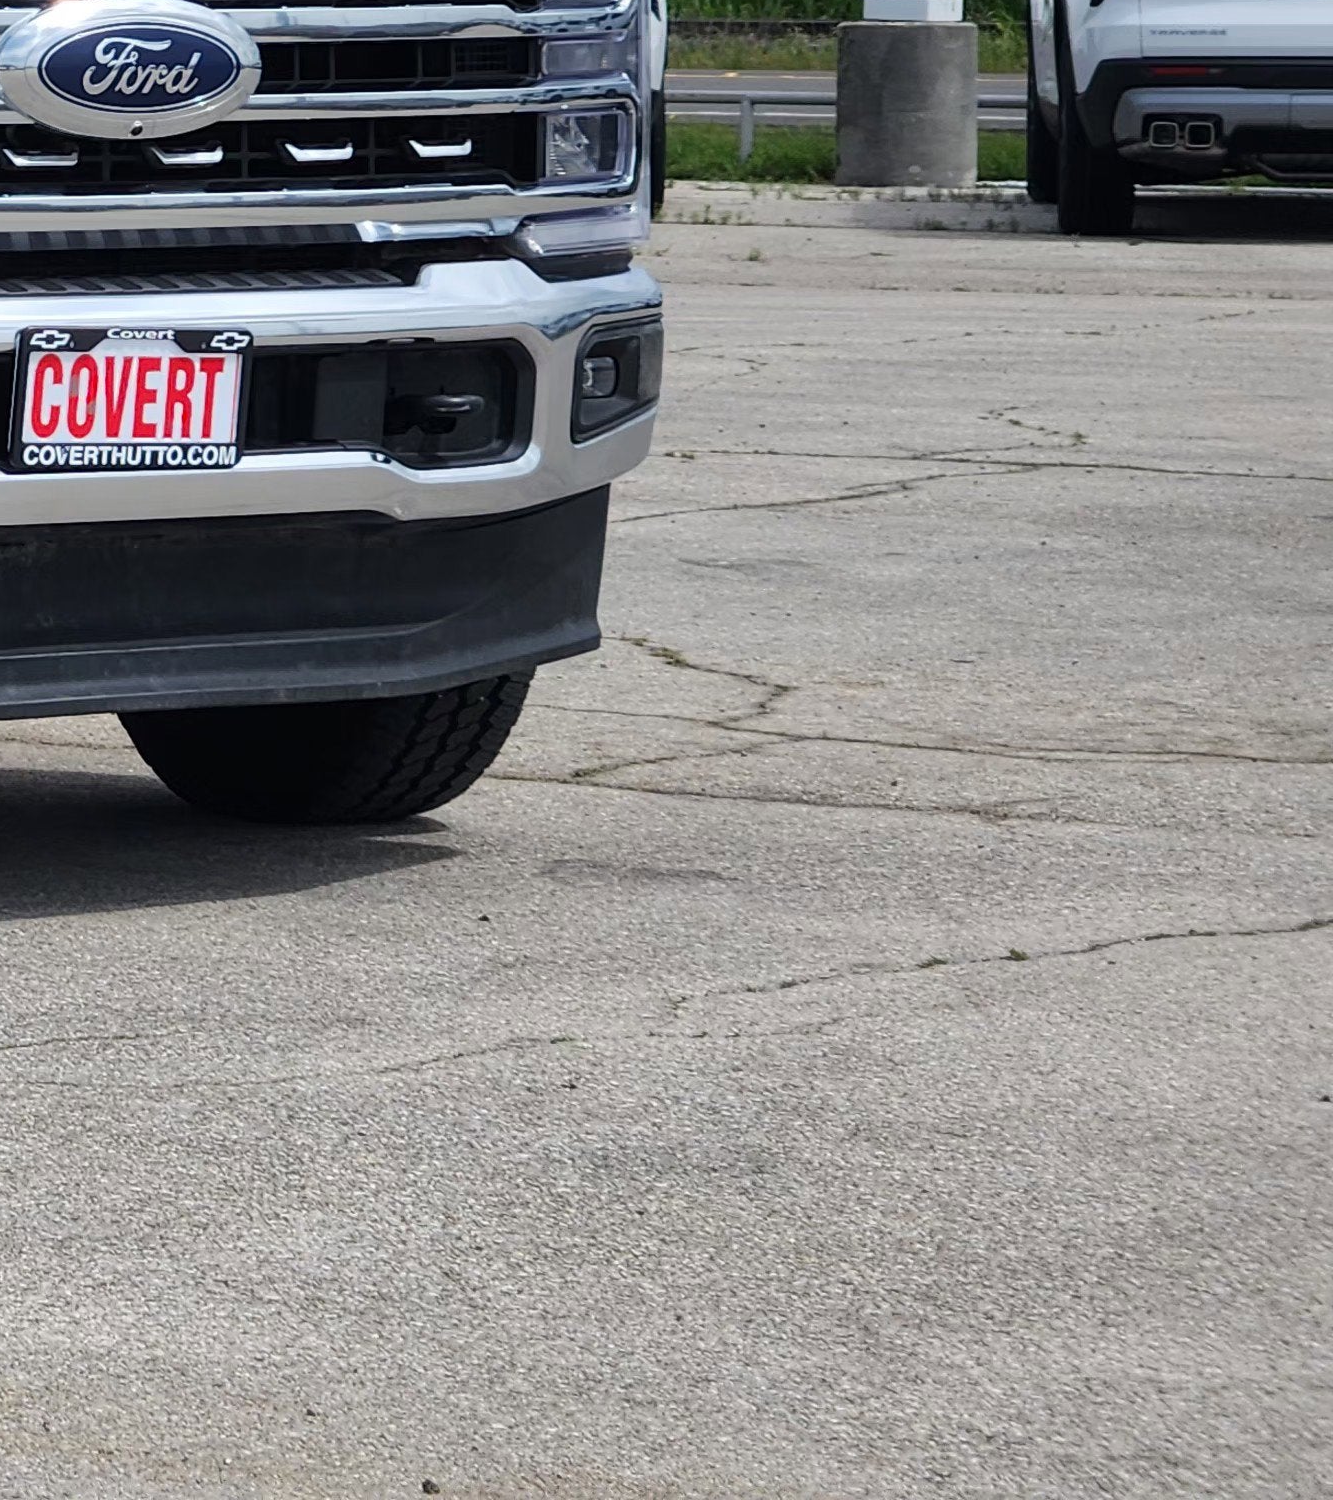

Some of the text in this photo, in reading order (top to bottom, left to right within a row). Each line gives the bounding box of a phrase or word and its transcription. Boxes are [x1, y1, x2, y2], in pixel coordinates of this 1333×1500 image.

[83, 37, 201, 95] Ford
[106, 328, 175, 340] Covert
[31, 354, 225, 438] COVERT
[23, 445, 236, 466] COVERTHUTTO.COM
